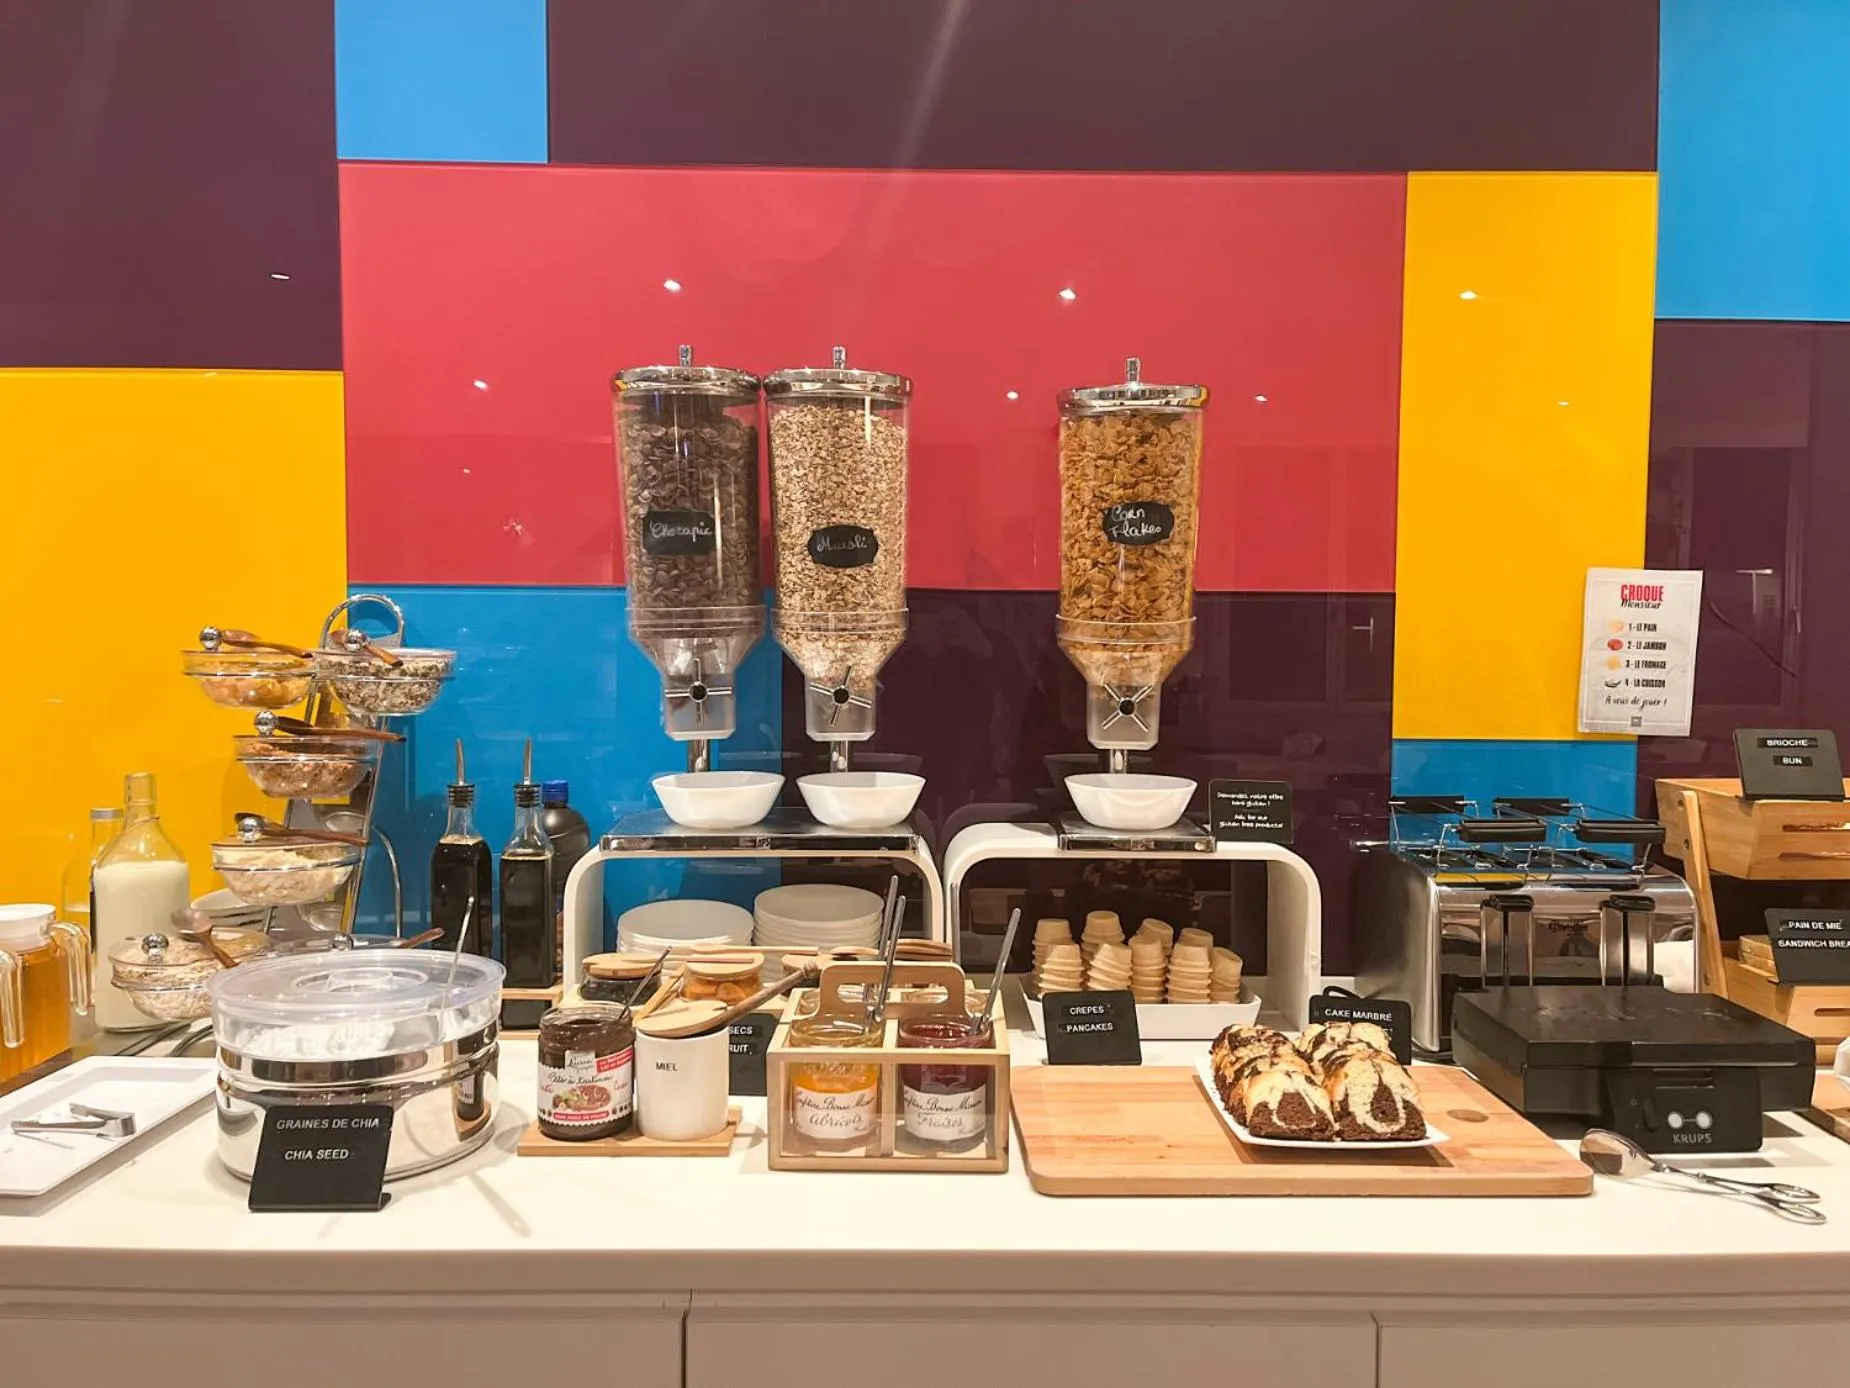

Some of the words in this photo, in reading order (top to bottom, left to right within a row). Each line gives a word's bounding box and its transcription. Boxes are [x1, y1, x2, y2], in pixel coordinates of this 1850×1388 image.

[1109, 521, 1162, 538] Flakes
[1620, 584, 1665, 601] CROQUE
[1620, 599, 1662, 610] Monsieur
[1636, 623, 1643, 632] LE
[1643, 623, 1657, 632] PAIN
[1627, 641, 1632, 650] 2
[1636, 642, 1643, 650] LE
[1643, 642, 1667, 651] JAMBON
[1634, 660, 1641, 668] LE
[1641, 660, 1667, 669] FROMAGE
[1766, 739, 1809, 747] BRIOCHE
[1782, 757, 1803, 765] BUN
[1788, 921, 1810, 929] PAIN
[1811, 921, 1824, 930] DE
[1825, 922, 1842, 930] MIE
[1778, 939, 1827, 948] SANDWICH
[1069, 1005, 1105, 1015] CREPES
[1324, 1008, 1351, 1018] CAKE
[728, 1025, 753, 1035] SECS
[1066, 1022, 1114, 1033] PANCAKES
[655, 1061, 679, 1072] MIEL
[276, 1119, 329, 1130] GRAINES
[332, 1118, 349, 1129] DE
[351, 1117, 380, 1129] CHIA
[1672, 1133, 1713, 1144] KRUPS
[284, 1150, 313, 1160] CHIA
[316, 1149, 349, 1160] SEED
